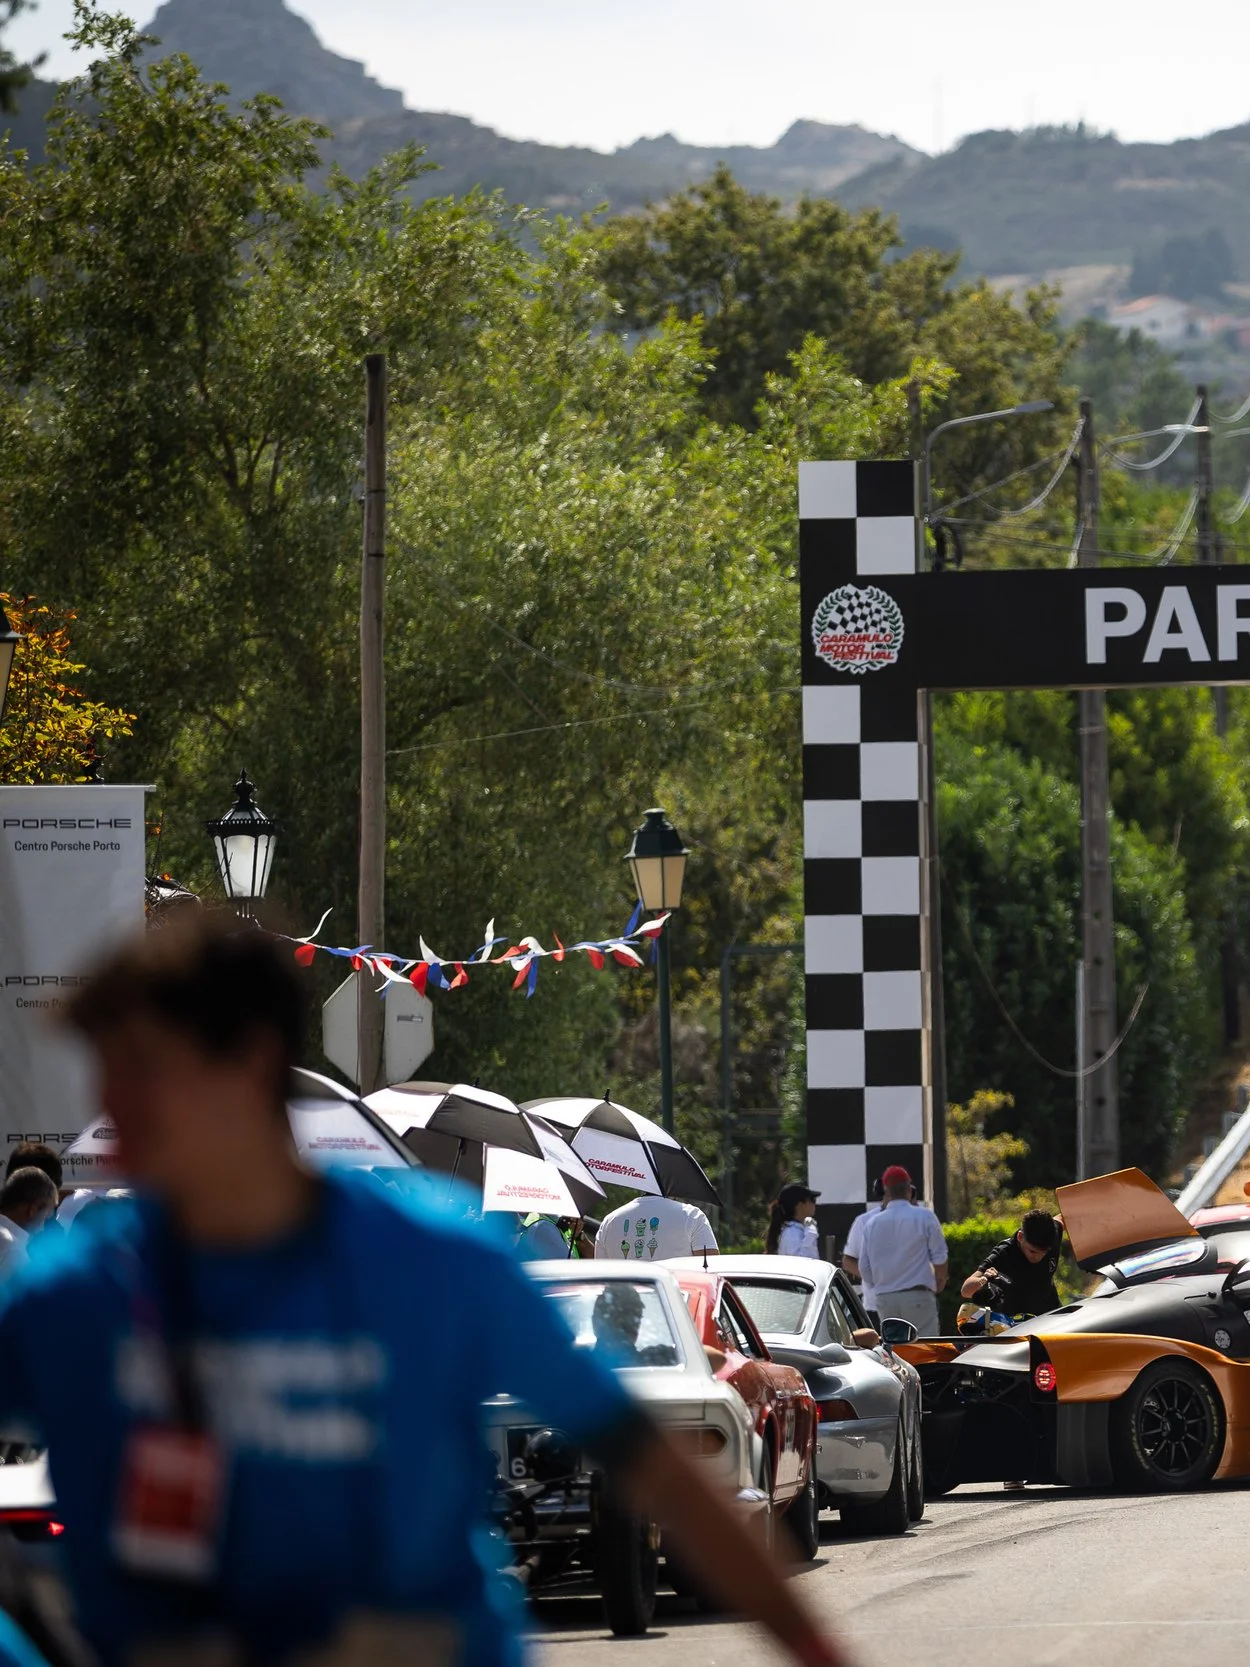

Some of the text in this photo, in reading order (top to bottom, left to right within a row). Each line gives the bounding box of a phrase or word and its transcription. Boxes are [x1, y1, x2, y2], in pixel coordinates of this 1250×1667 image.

[820, 633, 893, 643] CARAMULO
[819, 643, 865, 653] MOTOR
[832, 651, 894, 661] FESTIVAL
[3, 818, 132, 829] PORSCHE
[14, 840, 121, 852] Centro Porsche Porto
[5, 975, 96, 987] PORSC
[16, 997, 49, 1008] Centro
[7, 1133, 79, 1143] PORS
[60, 1154, 94, 1166] orsche
[588, 1158, 636, 1172] CARAMULO
[584, 1161, 647, 1179] OTORFESTIVAL
